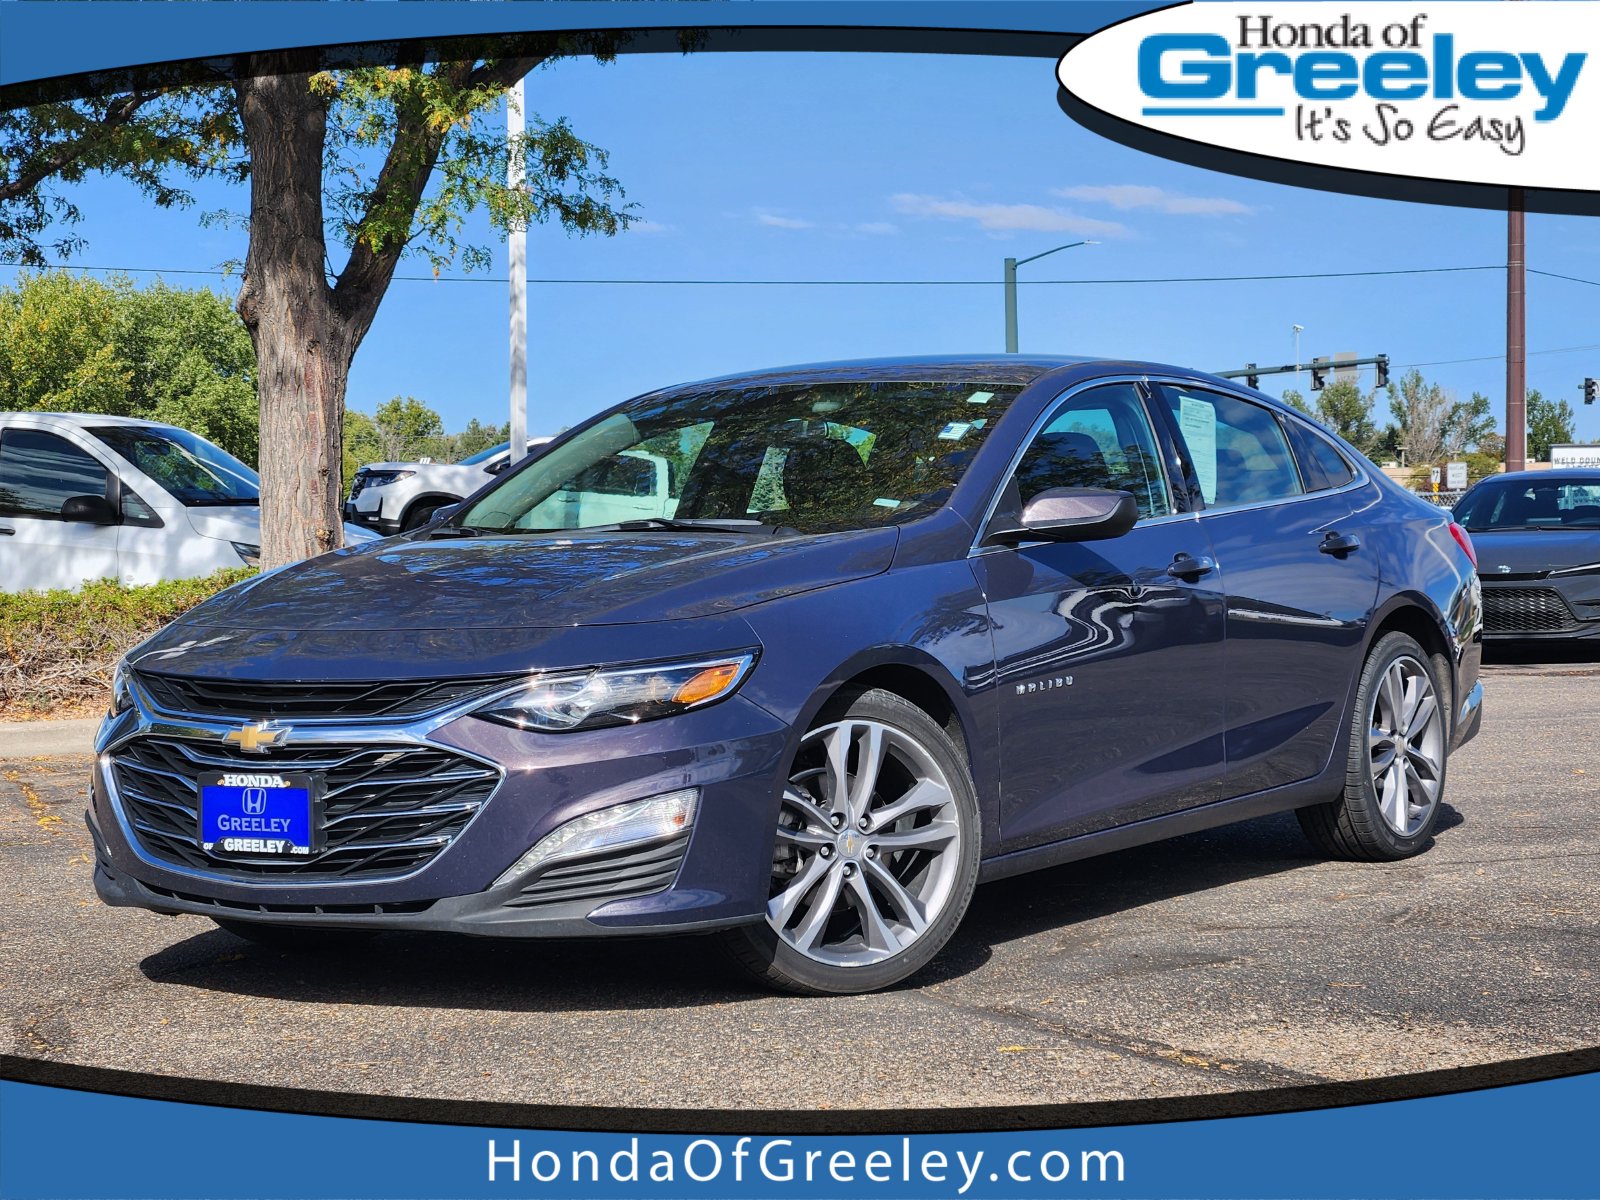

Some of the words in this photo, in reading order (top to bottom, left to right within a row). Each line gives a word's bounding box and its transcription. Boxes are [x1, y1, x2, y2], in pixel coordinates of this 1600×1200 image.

[1016, 675, 1073, 695] MALIBU
[223, 774, 286, 788] HONDA
[217, 814, 291, 832] GREELEY
[203, 842, 214, 851] OF
[223, 838, 286, 854] GREELEY
